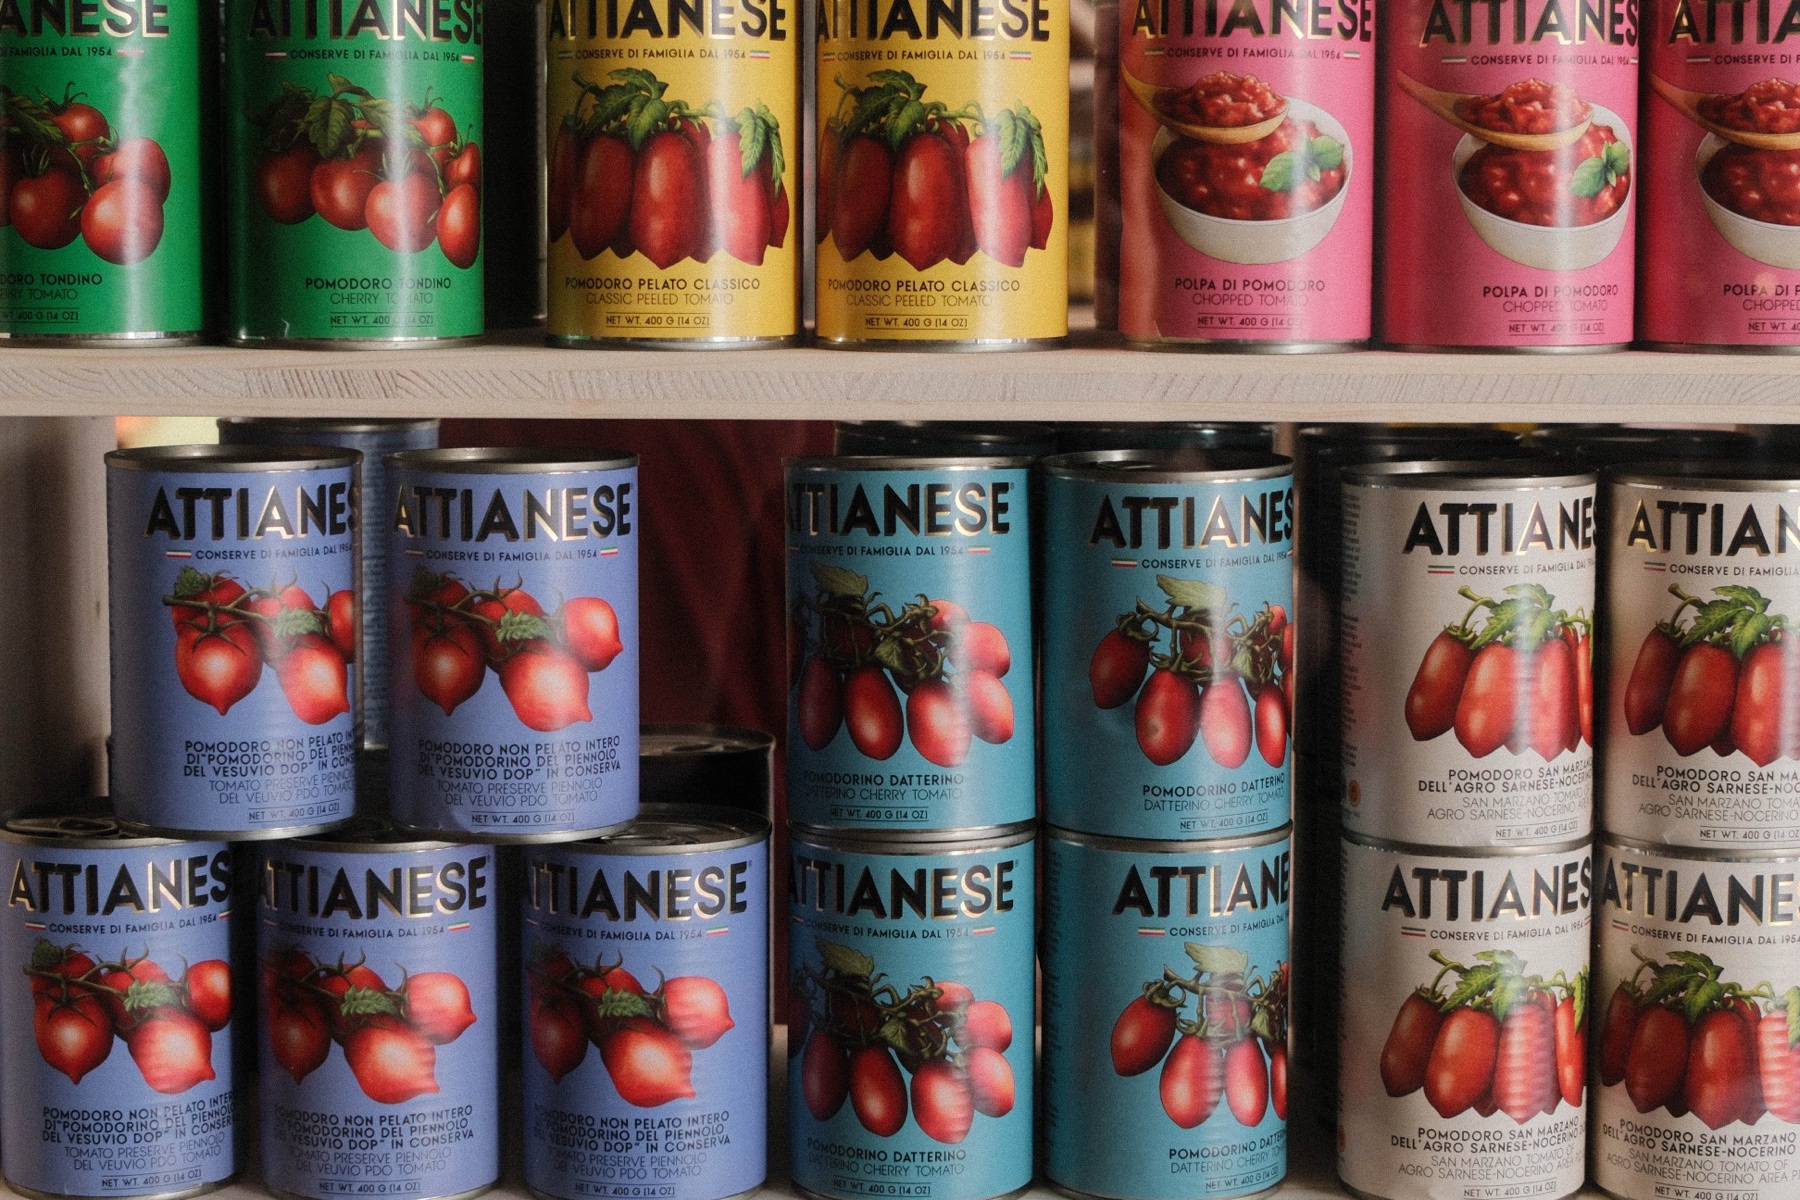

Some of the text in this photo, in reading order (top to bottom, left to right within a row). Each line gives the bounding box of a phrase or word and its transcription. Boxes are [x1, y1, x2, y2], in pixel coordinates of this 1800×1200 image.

[549, 0, 787, 41] ATTIANESE
[1132, 0, 1372, 42] ATTIANESE
[61, 46, 82, 57] DAL
[87, 46, 112, 57] 1954
[289, 49, 348, 61] CONSERVE
[575, 49, 694, 60] CONSERVE FAMIGLIA
[837, 50, 977, 61] CONSERVE FAMIGLIA DAL
[1167, 47, 1340, 61] CONSERVE FAMIGLIA 1954
[1470, 54, 1597, 66] CONSERVE DI FAMIGLIA
[1714, 54, 1791, 65] CONSERVE DI
[41, 274, 102, 286] TONDINO
[305, 278, 450, 290] POMODORO TONDINO
[565, 277, 687, 290] POMODORO PELATO
[828, 279, 1020, 292] POMODORO PELATO CLASSICO
[1174, 279, 1324, 292] POLPA DI POMODORO
[30, 289, 77, 301] TOMATO
[1482, 285, 1618, 298] POLPA DI POMODORO
[1722, 284, 1788, 297] POLPA DI
[329, 293, 380, 305] CHERRY
[586, 293, 678, 305] CLASSIC PEELED
[894, 295, 935, 307] PEELED
[1192, 294, 1253, 307] CHOPPED
[330, 316, 347, 325] NET
[644, 316, 662, 325] 400
[394, 482, 631, 543] ATTIANESE
[789, 482, 1010, 537] TTIANESE
[195, 547, 320, 561] CONSERVE FAMIGLIA
[499, 550, 550, 562] FAMIGLIA
[860, 545, 963, 557] FAMIGLIA DAL 1954
[1141, 555, 1260, 570] CONSERVE FAMIGLIA
[1669, 563, 1728, 576] CONSERVE
[1458, 564, 1519, 576] CONSERVE
[184, 734, 342, 752] POMODORO PELATO
[585, 736, 620, 752] INTERO
[565, 749, 616, 765] PIENNOLO
[212, 765, 275, 778] VESUVIO
[564, 761, 621, 777] CONSERVA
[1448, 767, 1559, 782] POMODORO SAN
[1656, 766, 1774, 783] POMODORO SAN
[209, 776, 318, 792] TOMATO PRESERVE
[551, 778, 602, 794] PIENNOLO
[889, 774, 963, 787] DATTERINO
[1142, 774, 1285, 798] POMODORINO DATTERINO
[552, 791, 597, 805] TOMATO
[859, 789, 962, 801] CHERRY TOMATO
[1462, 793, 1549, 809] SAN MARZANO
[1668, 794, 1761, 810] SAN MARZANO
[1144, 796, 1254, 812] DATTERINO CHERRY
[1638, 803, 1670, 817] AGRO
[512, 815, 529, 824] 400
[864, 811, 881, 821] 400
[1426, 808, 1465, 820] AGRO
[1219, 818, 1233, 828] 400
[1495, 830, 1511, 838] NET
[1741, 831, 1759, 840] 400
[8, 851, 230, 916] ATTIANES
[1381, 856, 1591, 922] ATTIANES
[1600, 858, 1800, 927] ATTIANE
[125, 920, 174, 934] FAMIGLIA
[343, 927, 393, 940] FAMIGLIA
[866, 927, 941, 940] FAMIGLIA DAL
[1168, 925, 1227, 938] CONSERVE
[1429, 926, 1551, 942] CONSERVE FAMIGLIA
[600, 928, 650, 941] FAMIGLIA
[1630, 924, 1752, 946] CONSERVE FAMIGLIA
[42, 1100, 206, 1122] POMODORO PELATO
[379, 1105, 472, 1126] PELATO INTERO
[409, 1118, 468, 1137] PIENNOLO
[634, 1111, 730, 1130] PELATO INTERO
[665, 1124, 724, 1141] PIENNOLO
[1417, 1116, 1579, 1143] POMODORO MARZANO
[1619, 1119, 1796, 1146] POMODORO MARZANO
[66, 1133, 127, 1145] VESUVIO
[409, 1130, 473, 1147] CONSERVA
[665, 1135, 730, 1152] CONSERVA
[64, 1143, 174, 1159] TOMATO PRESERVE
[807, 1139, 966, 1163] POMODORINO DATTERINO
[1168, 1141, 1257, 1160] POMODORINO
[650, 1153, 707, 1168] PIENNOLO
[1170, 1153, 1269, 1174] DATTERINO CHERRY
[1460, 1155, 1521, 1168] MARZANO
[1652, 1155, 1769, 1172] MARZANO TOMATO
[398, 1161, 445, 1175] TOMATO
[652, 1165, 702, 1180] TOMATO
[863, 1163, 964, 1177] CHERRY TOMATO
[1397, 1163, 1433, 1179] AGRO
[143, 1175, 160, 1185] 400
[1205, 1181, 1220, 1190] NET
[358, 1184, 375, 1193] 400
[868, 1185, 884, 1194] 400
[1504, 1186, 1520, 1196] 400
[1654, 1187, 1670, 1196] NET
